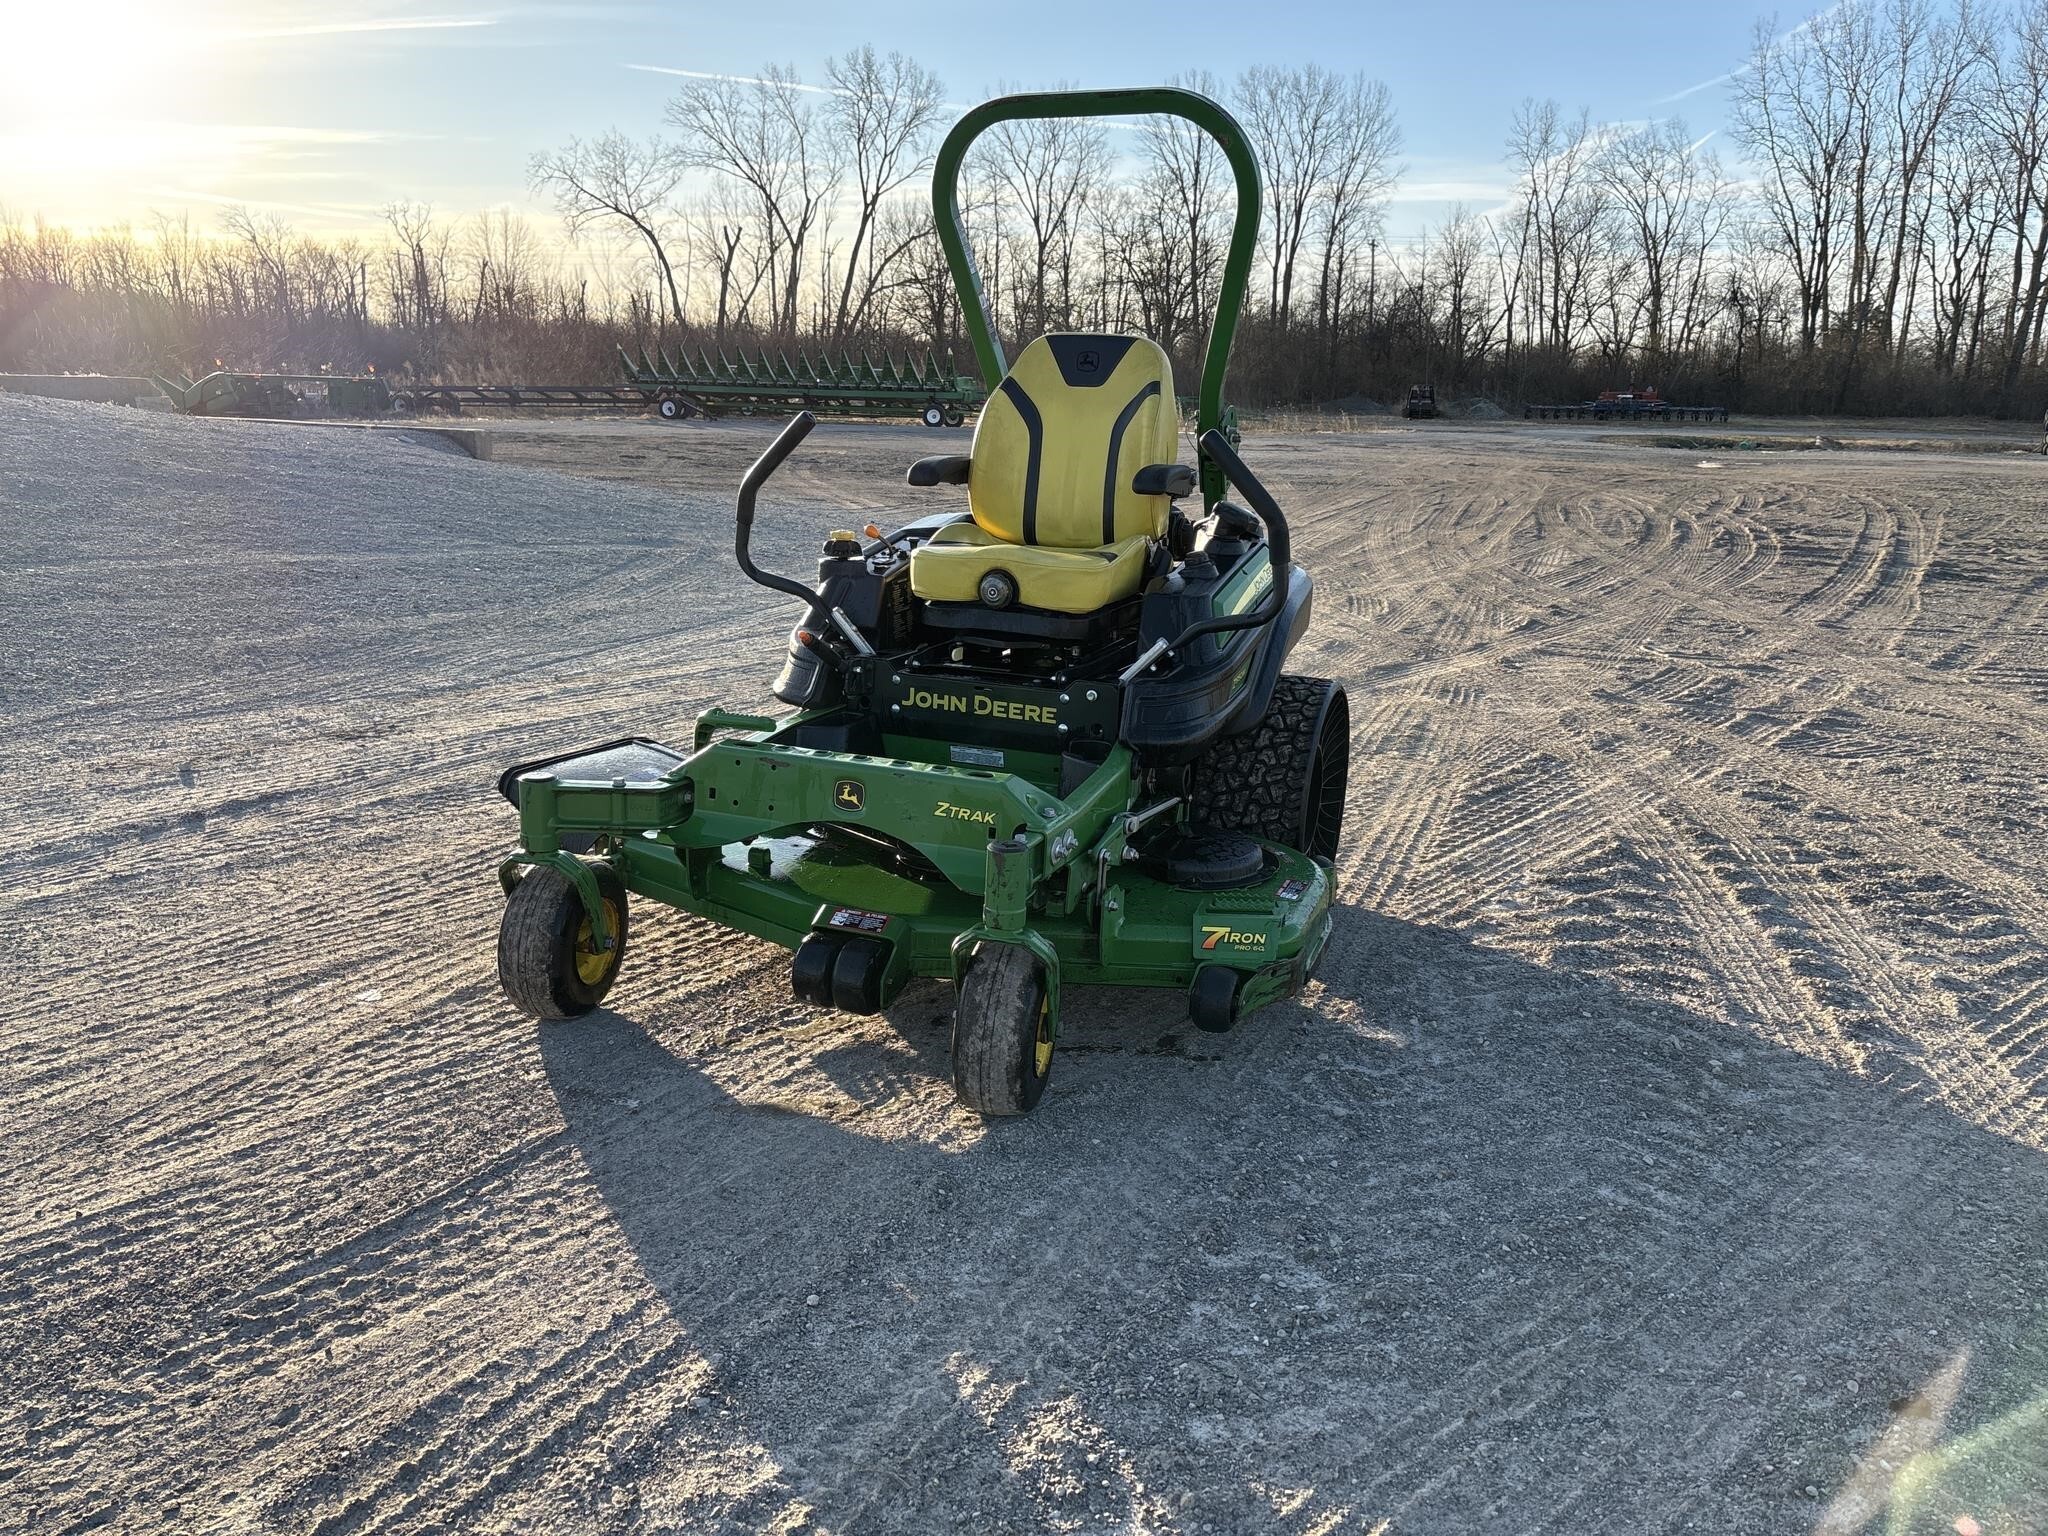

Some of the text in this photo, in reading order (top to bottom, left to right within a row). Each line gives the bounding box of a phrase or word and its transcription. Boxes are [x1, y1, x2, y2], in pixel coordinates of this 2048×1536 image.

[901, 687, 1057, 724] JOHN DEERE
[934, 801, 997, 824] ZTRAK
